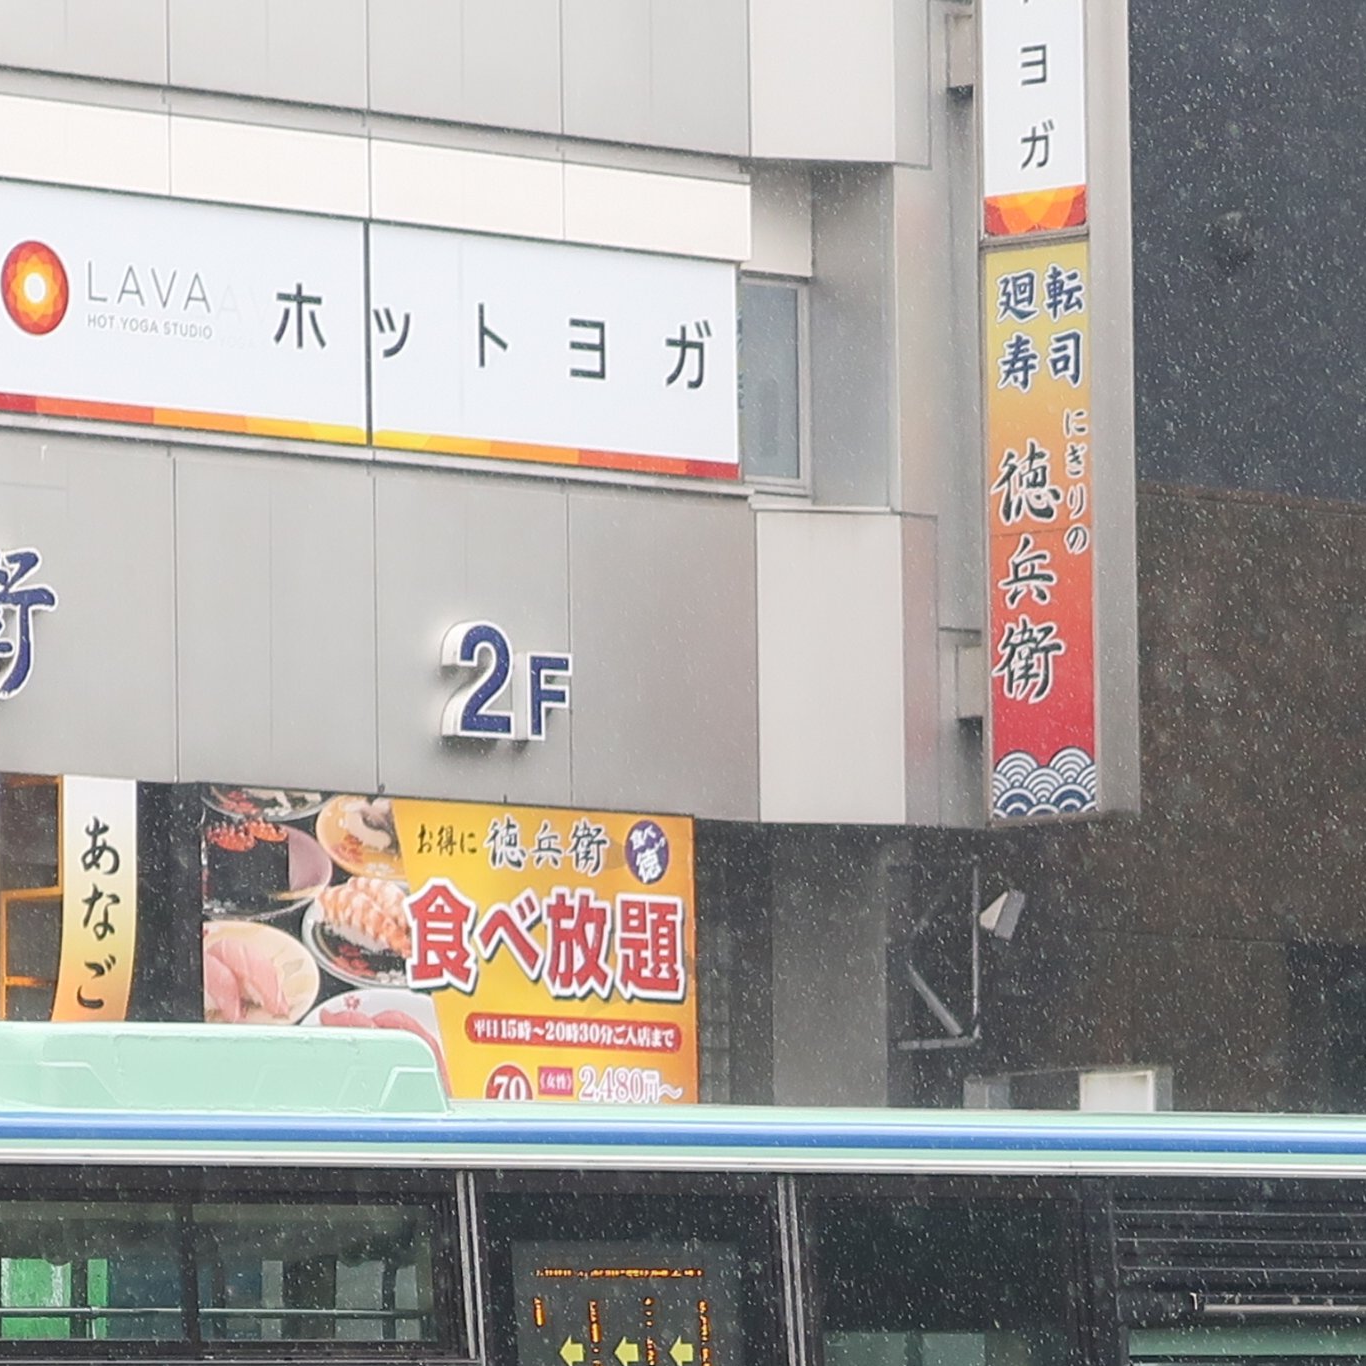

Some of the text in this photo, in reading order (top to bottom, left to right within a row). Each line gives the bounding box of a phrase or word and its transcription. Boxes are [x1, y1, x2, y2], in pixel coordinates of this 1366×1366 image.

[1020, 0, 1055, 170] ヨガ
[87, 259, 212, 315] LAVA
[87, 313, 214, 342] HOT YOGA STUDIO
[273, 282, 713, 390] ホットヨガ
[996, 264, 1085, 326] 廻転
[996, 330, 1084, 391] 寿司
[1063, 408, 1090, 556] にぎりの
[989, 438, 1065, 703] 徳兵衛
[455, 621, 573, 741] 2F
[415, 813, 609, 876] お得に 徳兵衛
[73, 816, 122, 1011] あなご
[405, 876, 686, 1002] 食べ放題
